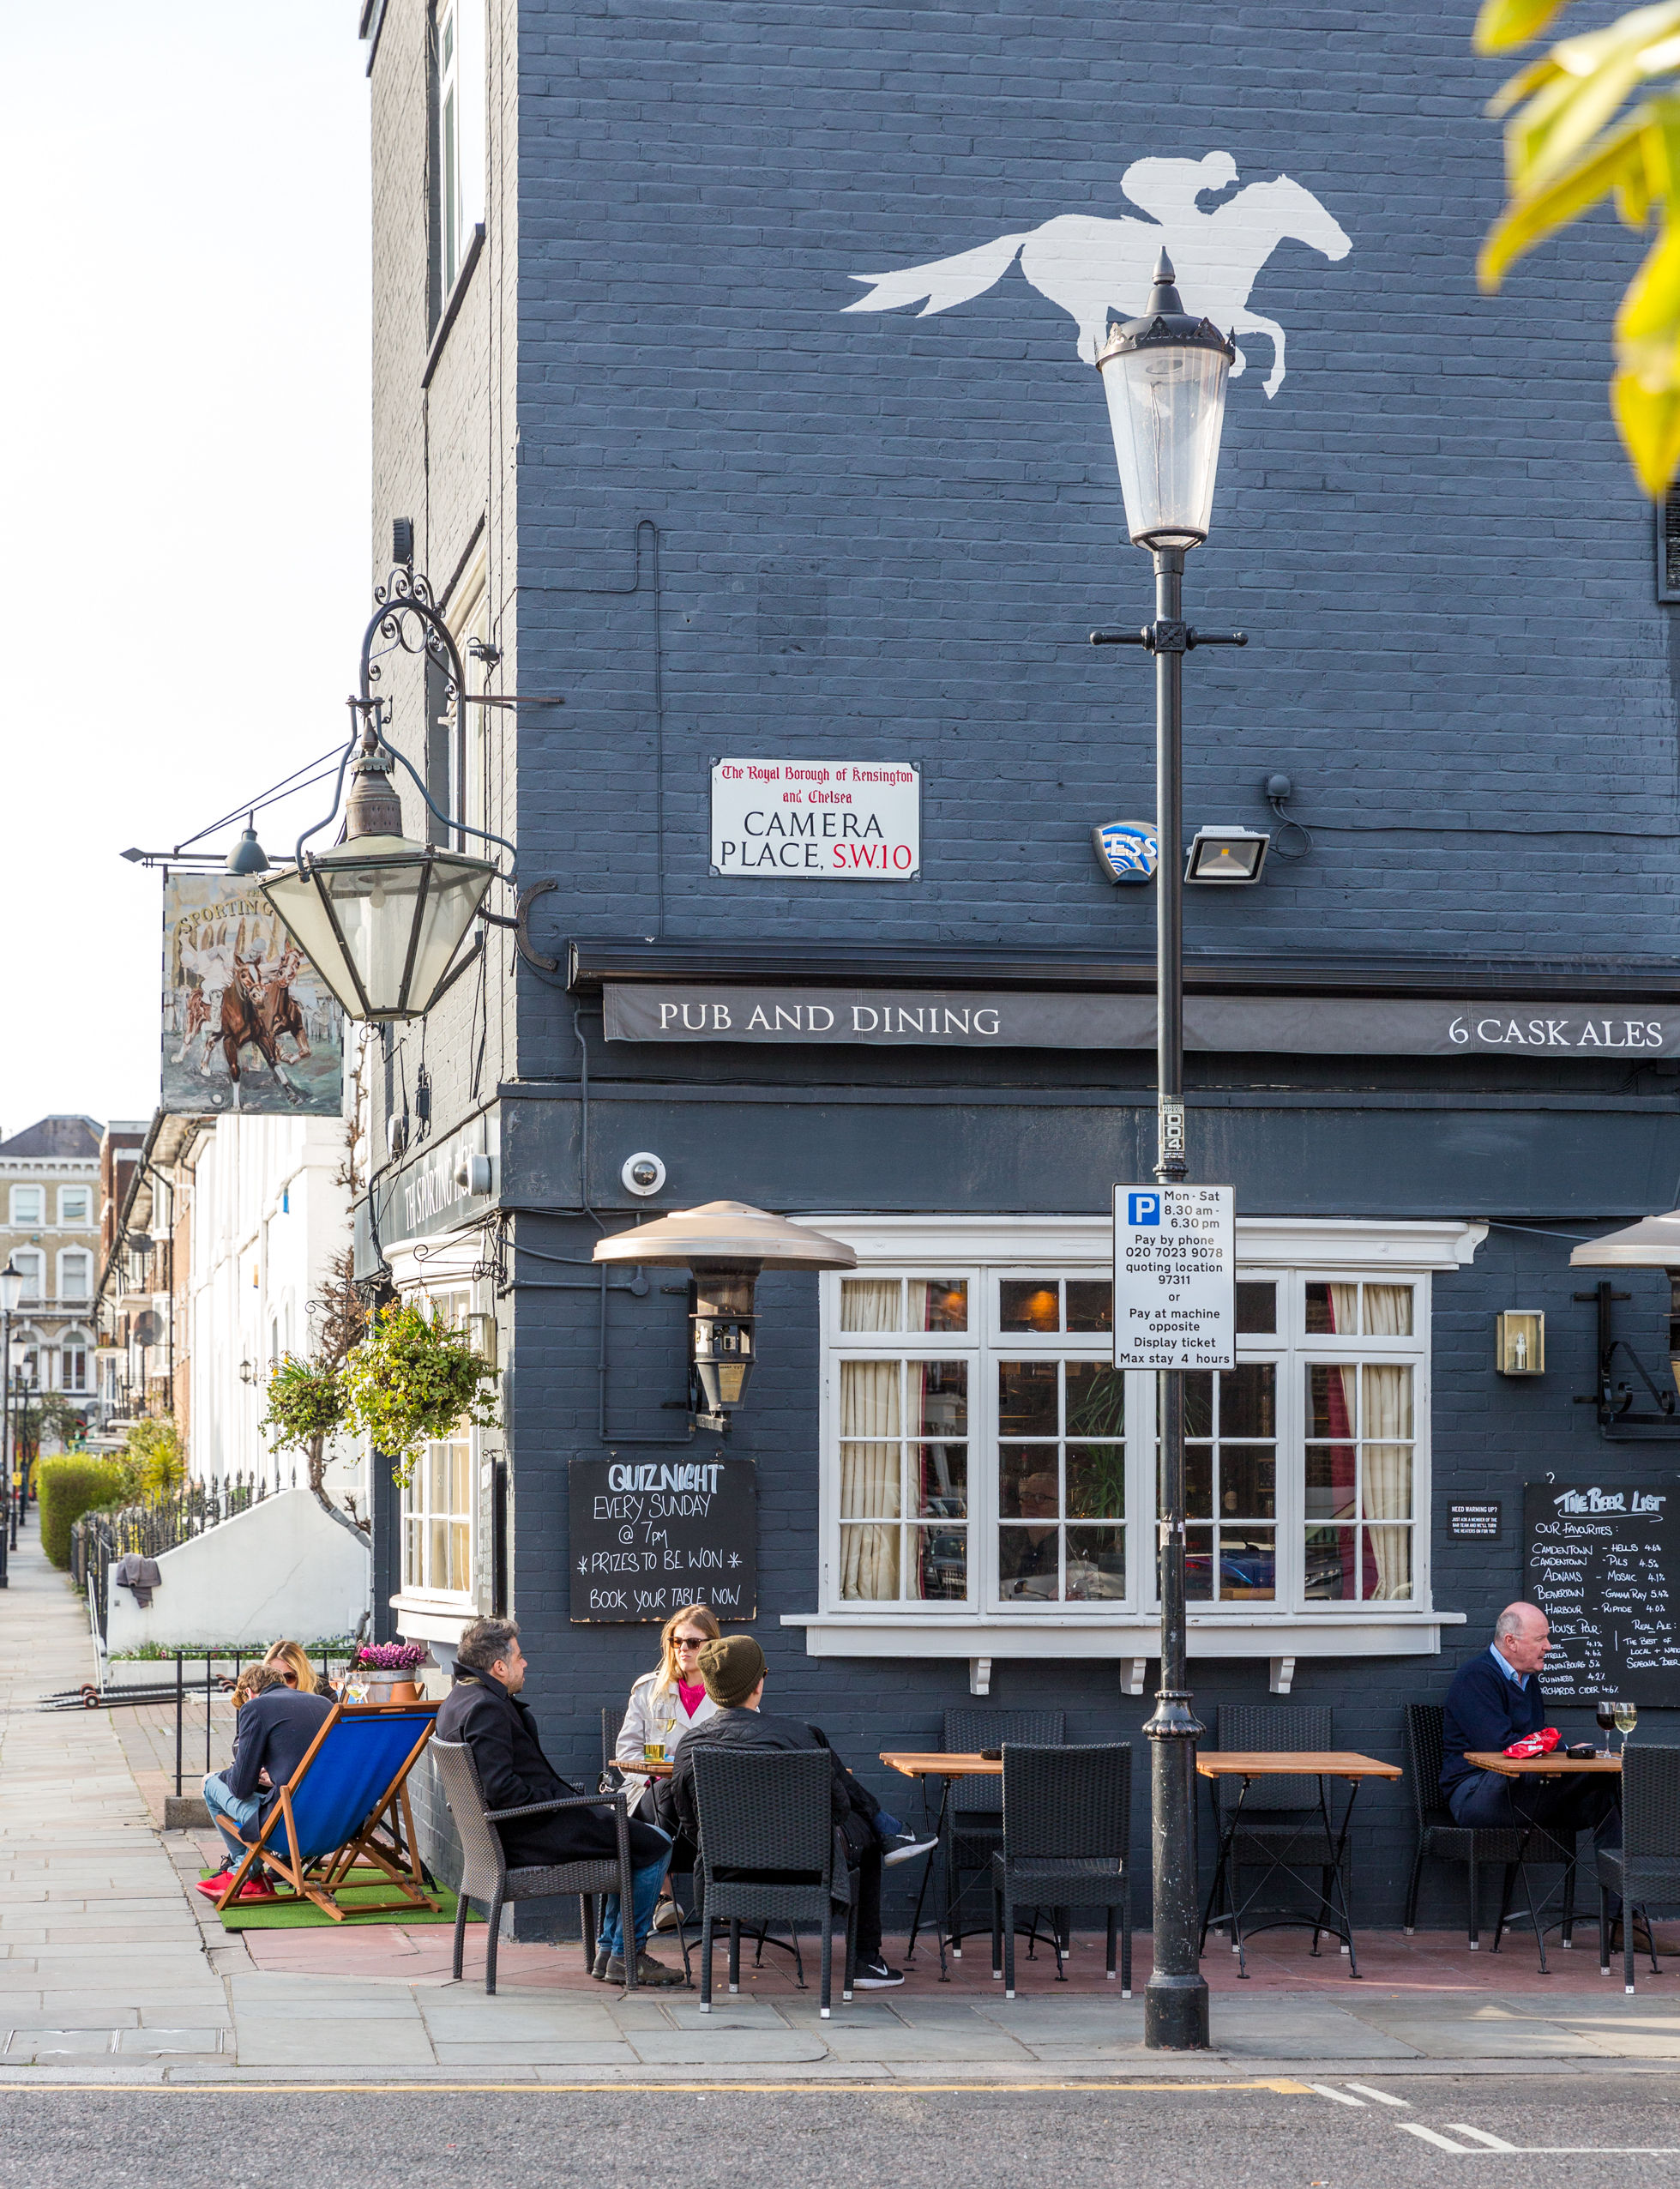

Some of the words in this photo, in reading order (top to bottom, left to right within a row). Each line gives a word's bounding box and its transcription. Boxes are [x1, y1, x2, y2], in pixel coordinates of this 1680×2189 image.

[722, 766, 744, 780] The
[747, 766, 780, 784] Royal
[786, 767, 829, 784] Borough
[836, 768, 847, 781] of
[852, 768, 912, 787] Kensington
[783, 790, 802, 803] and
[809, 790, 852, 804] Chelsea
[744, 811, 884, 838] CAMERA
[721, 841, 824, 870] PLACE,
[1110, 837, 1157, 858] ESS
[178, 900, 274, 934] SPORTING
[659, 1003, 732, 1030] PUB
[745, 1004, 834, 1031] AND
[852, 1005, 1001, 1034] DINING
[1448, 1017, 1469, 1044] 6
[1477, 1019, 1570, 1046] CASK
[1577, 1021, 1663, 1047] ALES
[417, 1156, 453, 1223] SPORTING
[1165, 1191, 1189, 1201] Mon
[1200, 1191, 1219, 1201] Sat
[1136, 1197, 1155, 1222] P
[1165, 1206, 1192, 1215] 8.30
[1195, 1207, 1213, 1215] am
[1171, 1219, 1199, 1228] 6.30
[1202, 1221, 1219, 1229] pm
[1135, 1235, 1156, 1245] Pay
[1161, 1235, 1173, 1245] by
[1178, 1236, 1213, 1246] phone
[1126, 1247, 1151, 1257] 020
[1156, 1248, 1186, 1257] 7023
[1192, 1248, 1223, 1258] 9078
[1126, 1263, 1171, 1273] quoting
[1176, 1263, 1222, 1272] location
[1159, 1275, 1190, 1285] 97311
[1130, 1309, 1150, 1319] Pay
[1155, 1310, 1166, 1318] at
[1171, 1309, 1220, 1318] machine
[1149, 1322, 1200, 1332] opposite
[1135, 1337, 1177, 1348] Display
[1182, 1338, 1215, 1347] ticket
[1121, 1354, 1144, 1363] Max
[1149, 1354, 1173, 1365] stay
[1182, 1354, 1189, 1363] 4
[1196, 1354, 1230, 1363] hours
[594, 1495, 644, 1525] EVERY
[649, 1493, 711, 1517] SUNDAY
[619, 1525, 633, 1544] @
[592, 1552, 639, 1573] PRIZES
[641, 1553, 657, 1571] TO
[664, 1550, 683, 1570] BE
[689, 1547, 723, 1569] WON
[590, 1589, 628, 1609] BOOK
[634, 1589, 665, 1612] YOUR
[671, 1588, 706, 1607] TABLE
[712, 1585, 740, 1605] NOW
[1544, 1661, 1586, 1671] RONENBOURG
